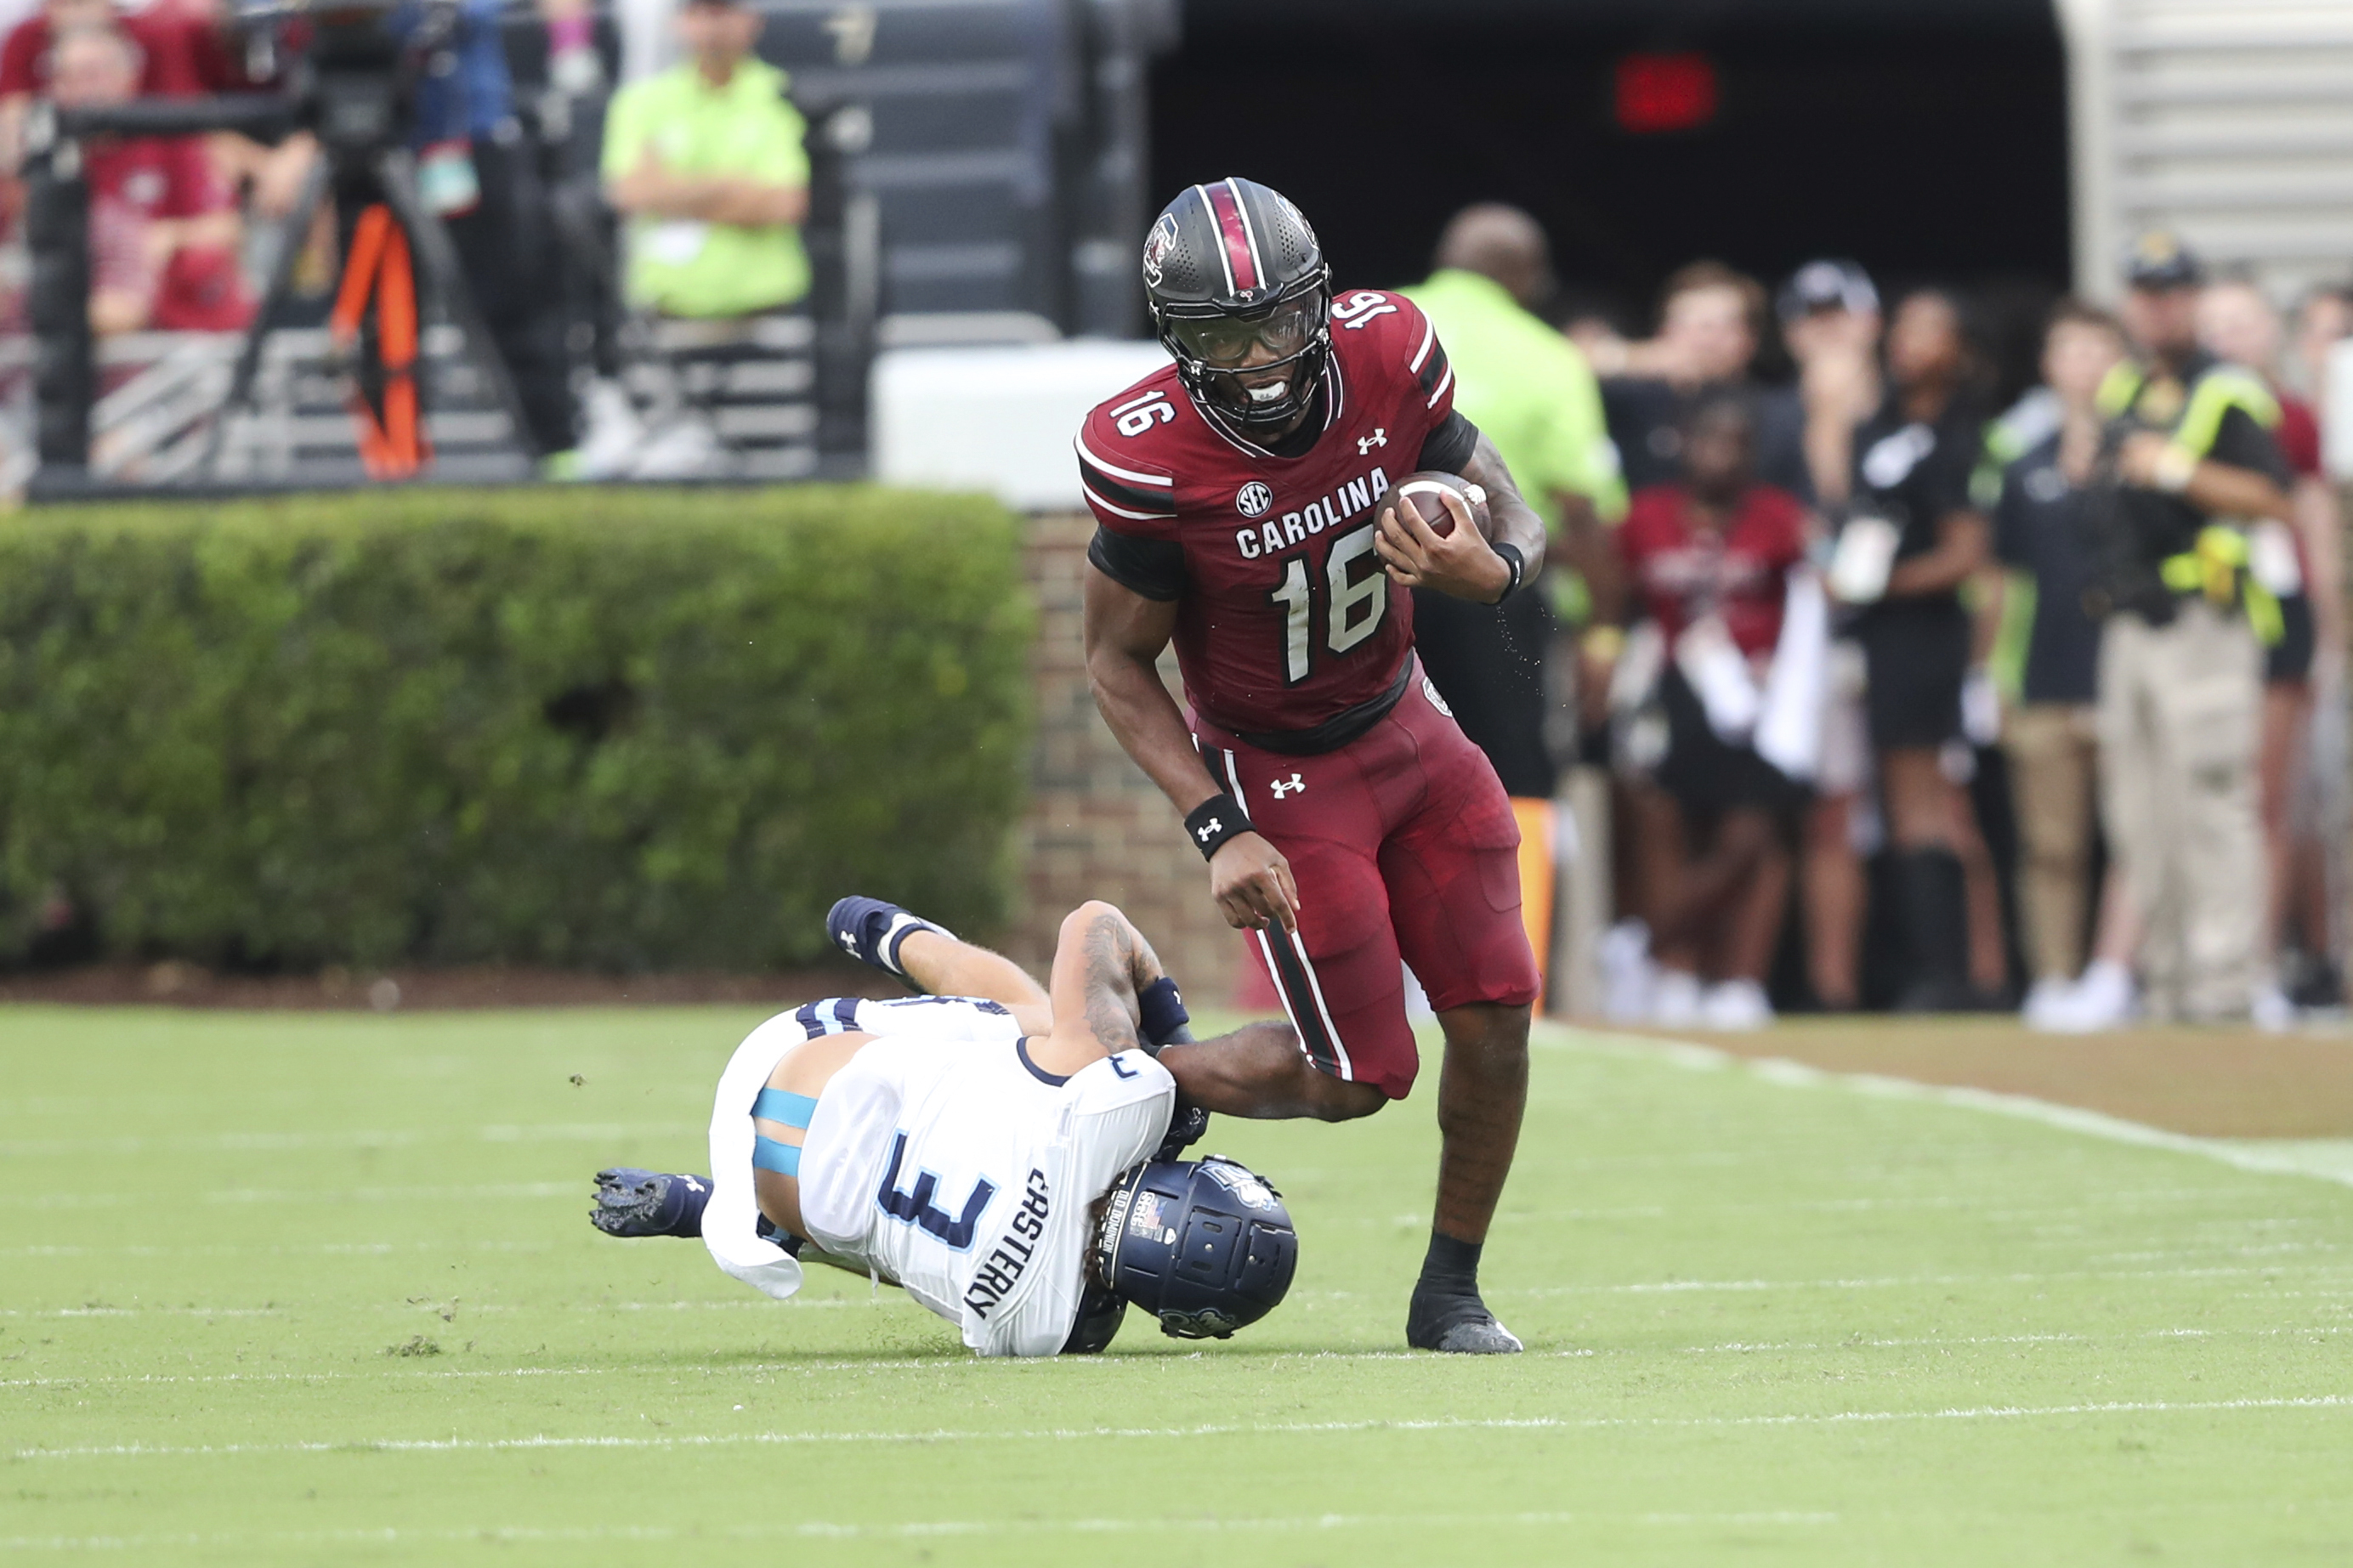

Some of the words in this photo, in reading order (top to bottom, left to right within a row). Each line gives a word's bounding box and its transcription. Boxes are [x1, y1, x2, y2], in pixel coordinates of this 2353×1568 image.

[1331, 292, 1398, 330] 16
[1109, 390, 1176, 437] 16
[1236, 467, 1390, 559] CAROLINA
[1239, 483, 1269, 514] SEC
[1271, 523, 1386, 682] 16
[875, 1128, 1001, 1254] 3
[1114, 1190, 1130, 1208] OLD
[963, 1168, 1049, 1320] EASTERLY
[1103, 1209, 1123, 1254] DOMINION
